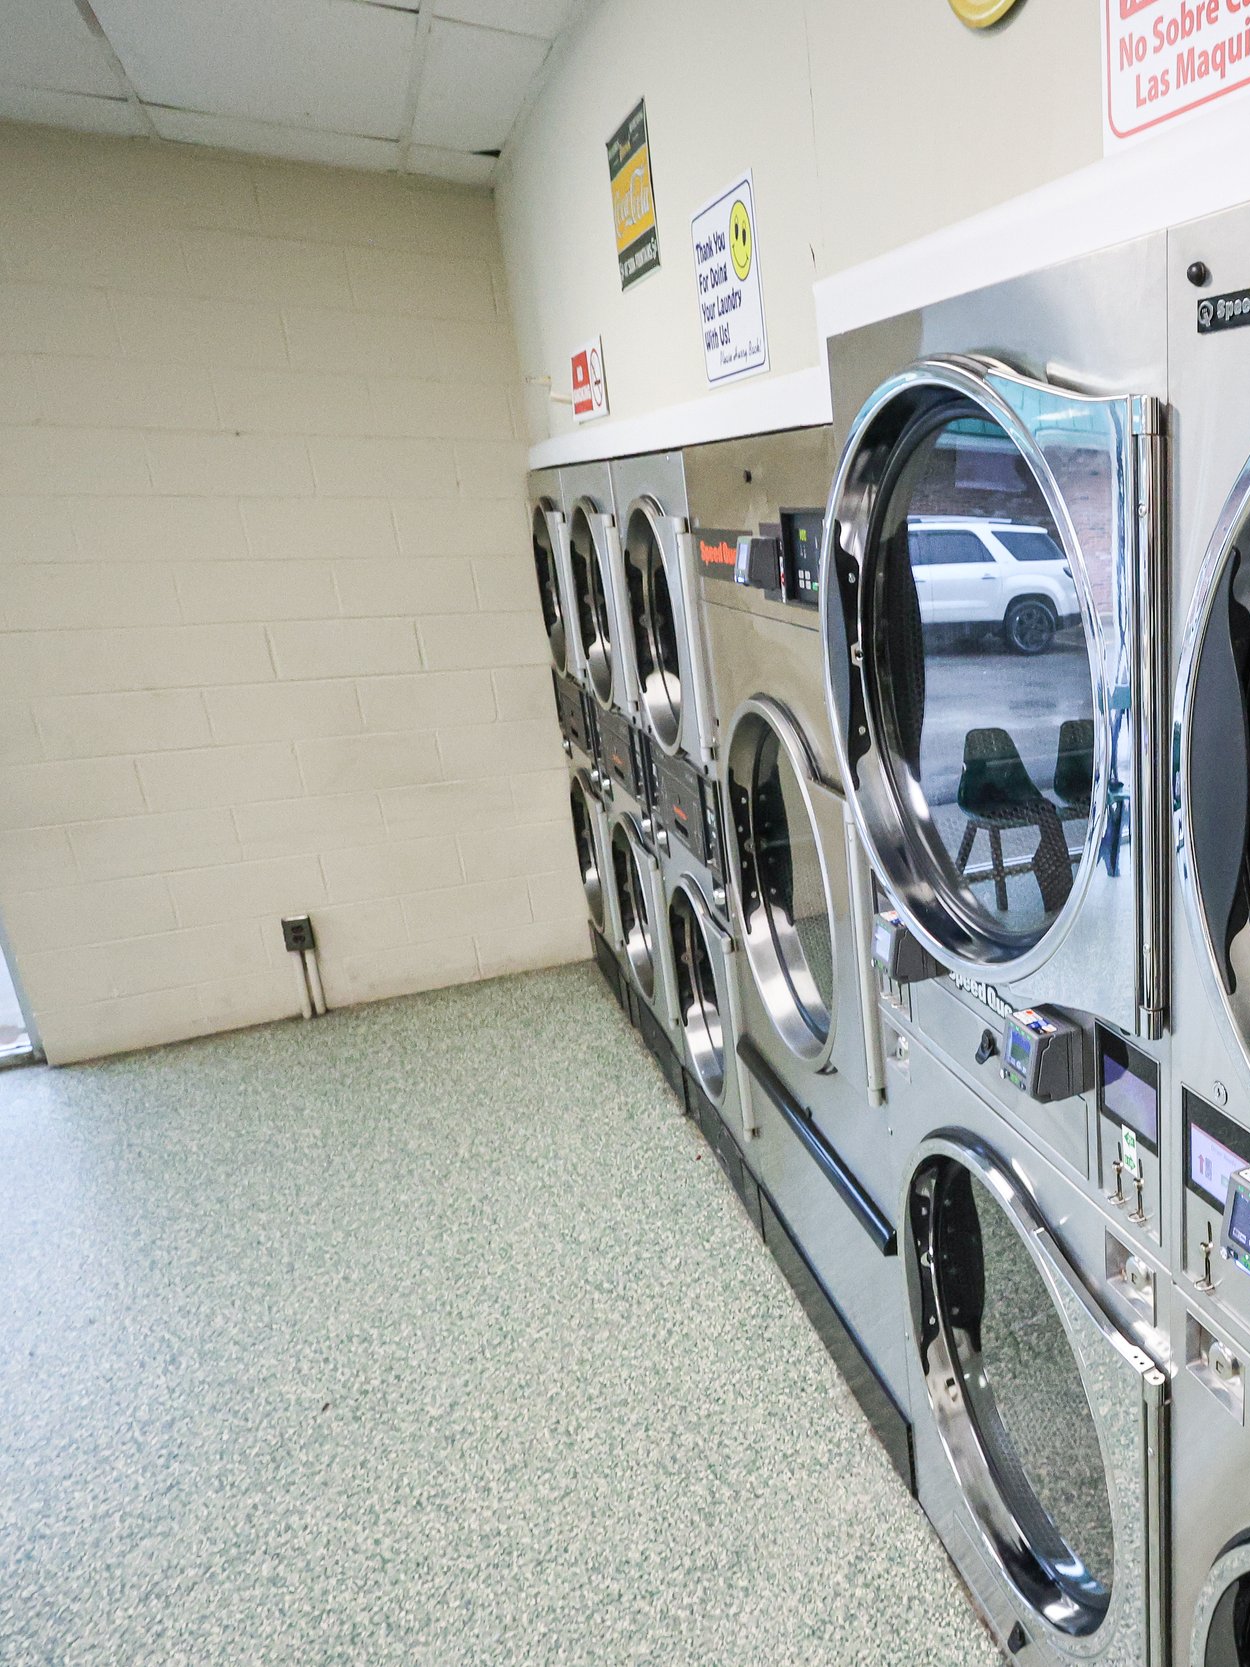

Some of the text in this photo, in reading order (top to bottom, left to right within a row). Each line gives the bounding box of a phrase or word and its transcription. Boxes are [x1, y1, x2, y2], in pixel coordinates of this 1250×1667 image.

[1119, 0, 1219, 72] No Sobre
[1135, 68, 1170, 108] Las
[695, 231, 726, 265] Thank You
[699, 262, 728, 295] For Doing
[701, 288, 742, 323] Your Laundry
[704, 322, 731, 352] With Us!
[700, 540, 737, 566] Speed Que
[987, 986, 1014, 1019] Que
